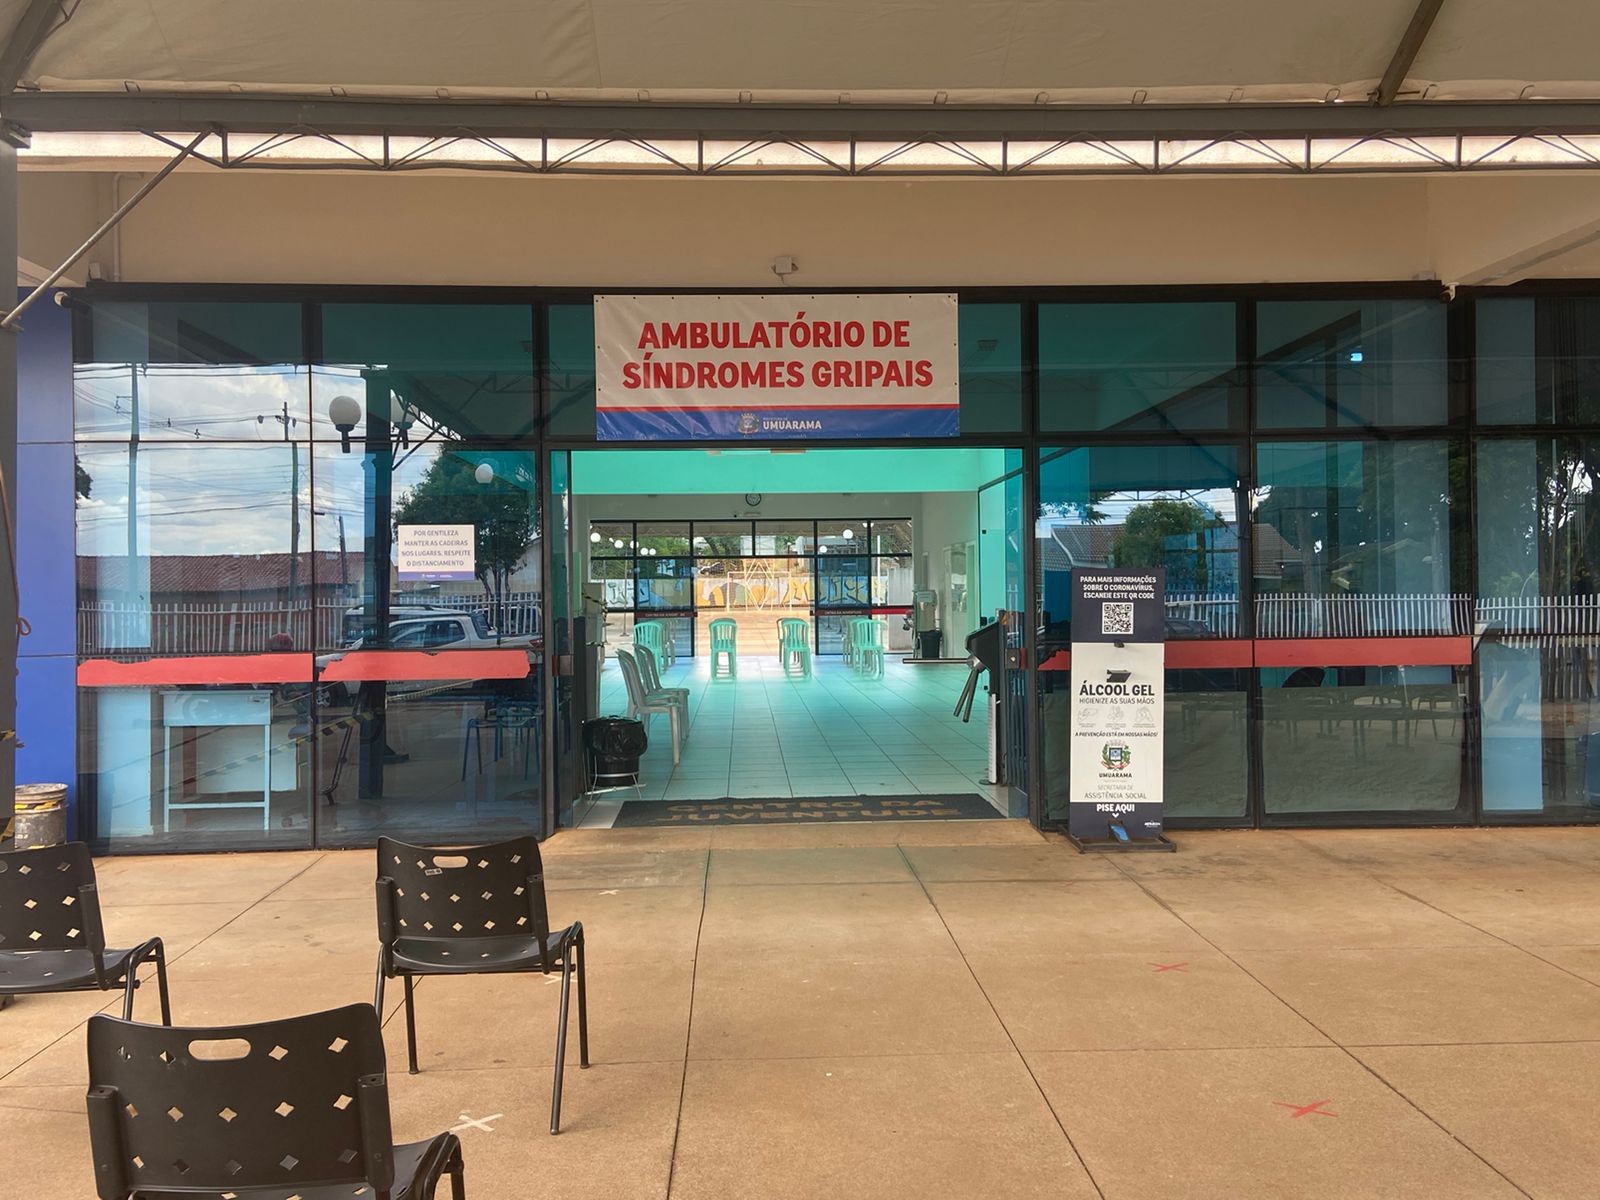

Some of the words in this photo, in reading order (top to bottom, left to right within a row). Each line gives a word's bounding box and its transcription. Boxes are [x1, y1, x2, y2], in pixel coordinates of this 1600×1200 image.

[638, 311, 866, 349] AMBULATÓRIO
[872, 320, 910, 348] DE
[622, 352, 805, 390] SÍNDROMES
[811, 359, 934, 388] GRIPAIS
[763, 420, 822, 430] UMUARAMA
[1113, 575, 1157, 584] INFORMAÇÕES
[1109, 583, 1155, 591] CORONAVÍRUS,
[1128, 592, 1138, 600] QR
[1080, 680, 1129, 696] ÁLCOOL
[1132, 684, 1155, 696] GEL
[1084, 791, 1123, 799] ASSISTÊNCIA
[667, 801, 863, 812] CENTRO
[1096, 803, 1114, 812] PISE
[1115, 803, 1135, 814] AQUI
[656, 808, 962, 821] JUVENTUDE
